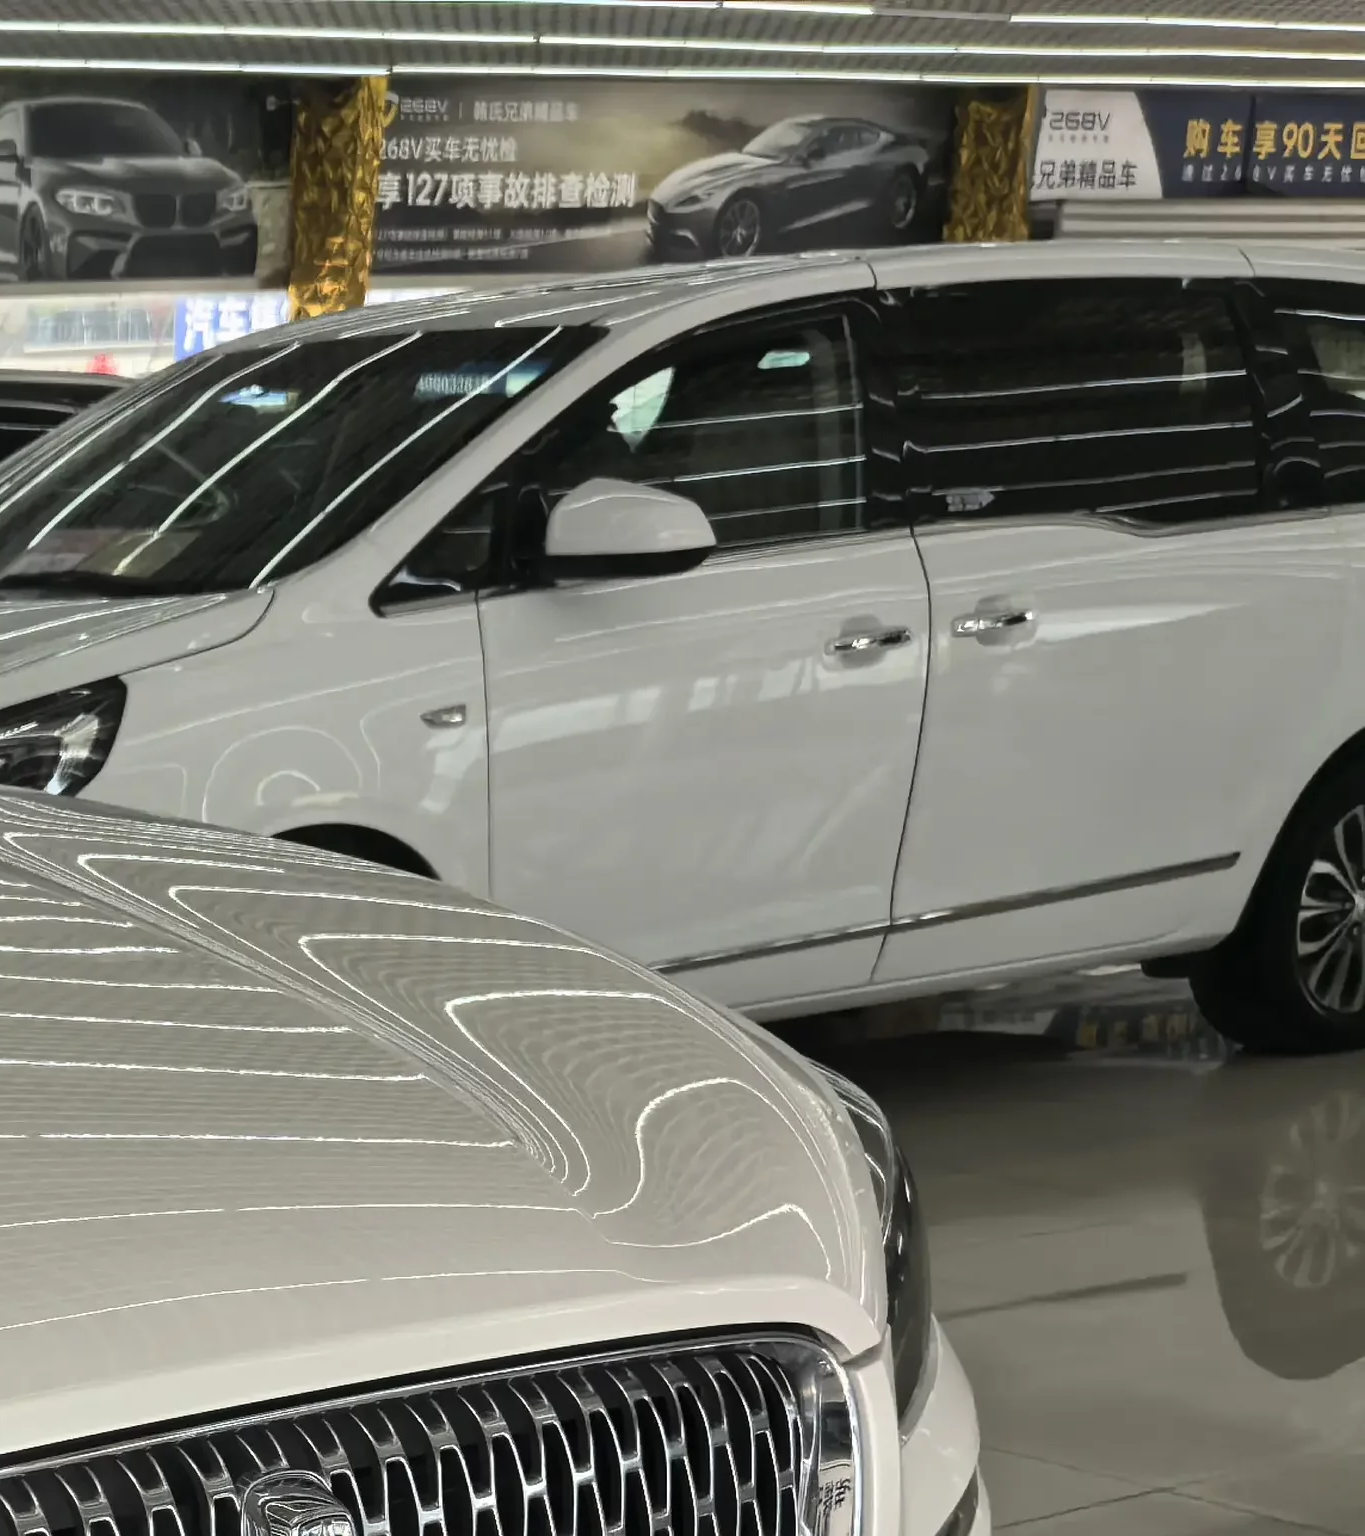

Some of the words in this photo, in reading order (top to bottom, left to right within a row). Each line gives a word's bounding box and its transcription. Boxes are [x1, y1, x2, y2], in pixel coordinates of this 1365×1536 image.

[1049, 111, 1111, 132] 268V
[1036, 159, 1138, 191] 兄弟精品车
